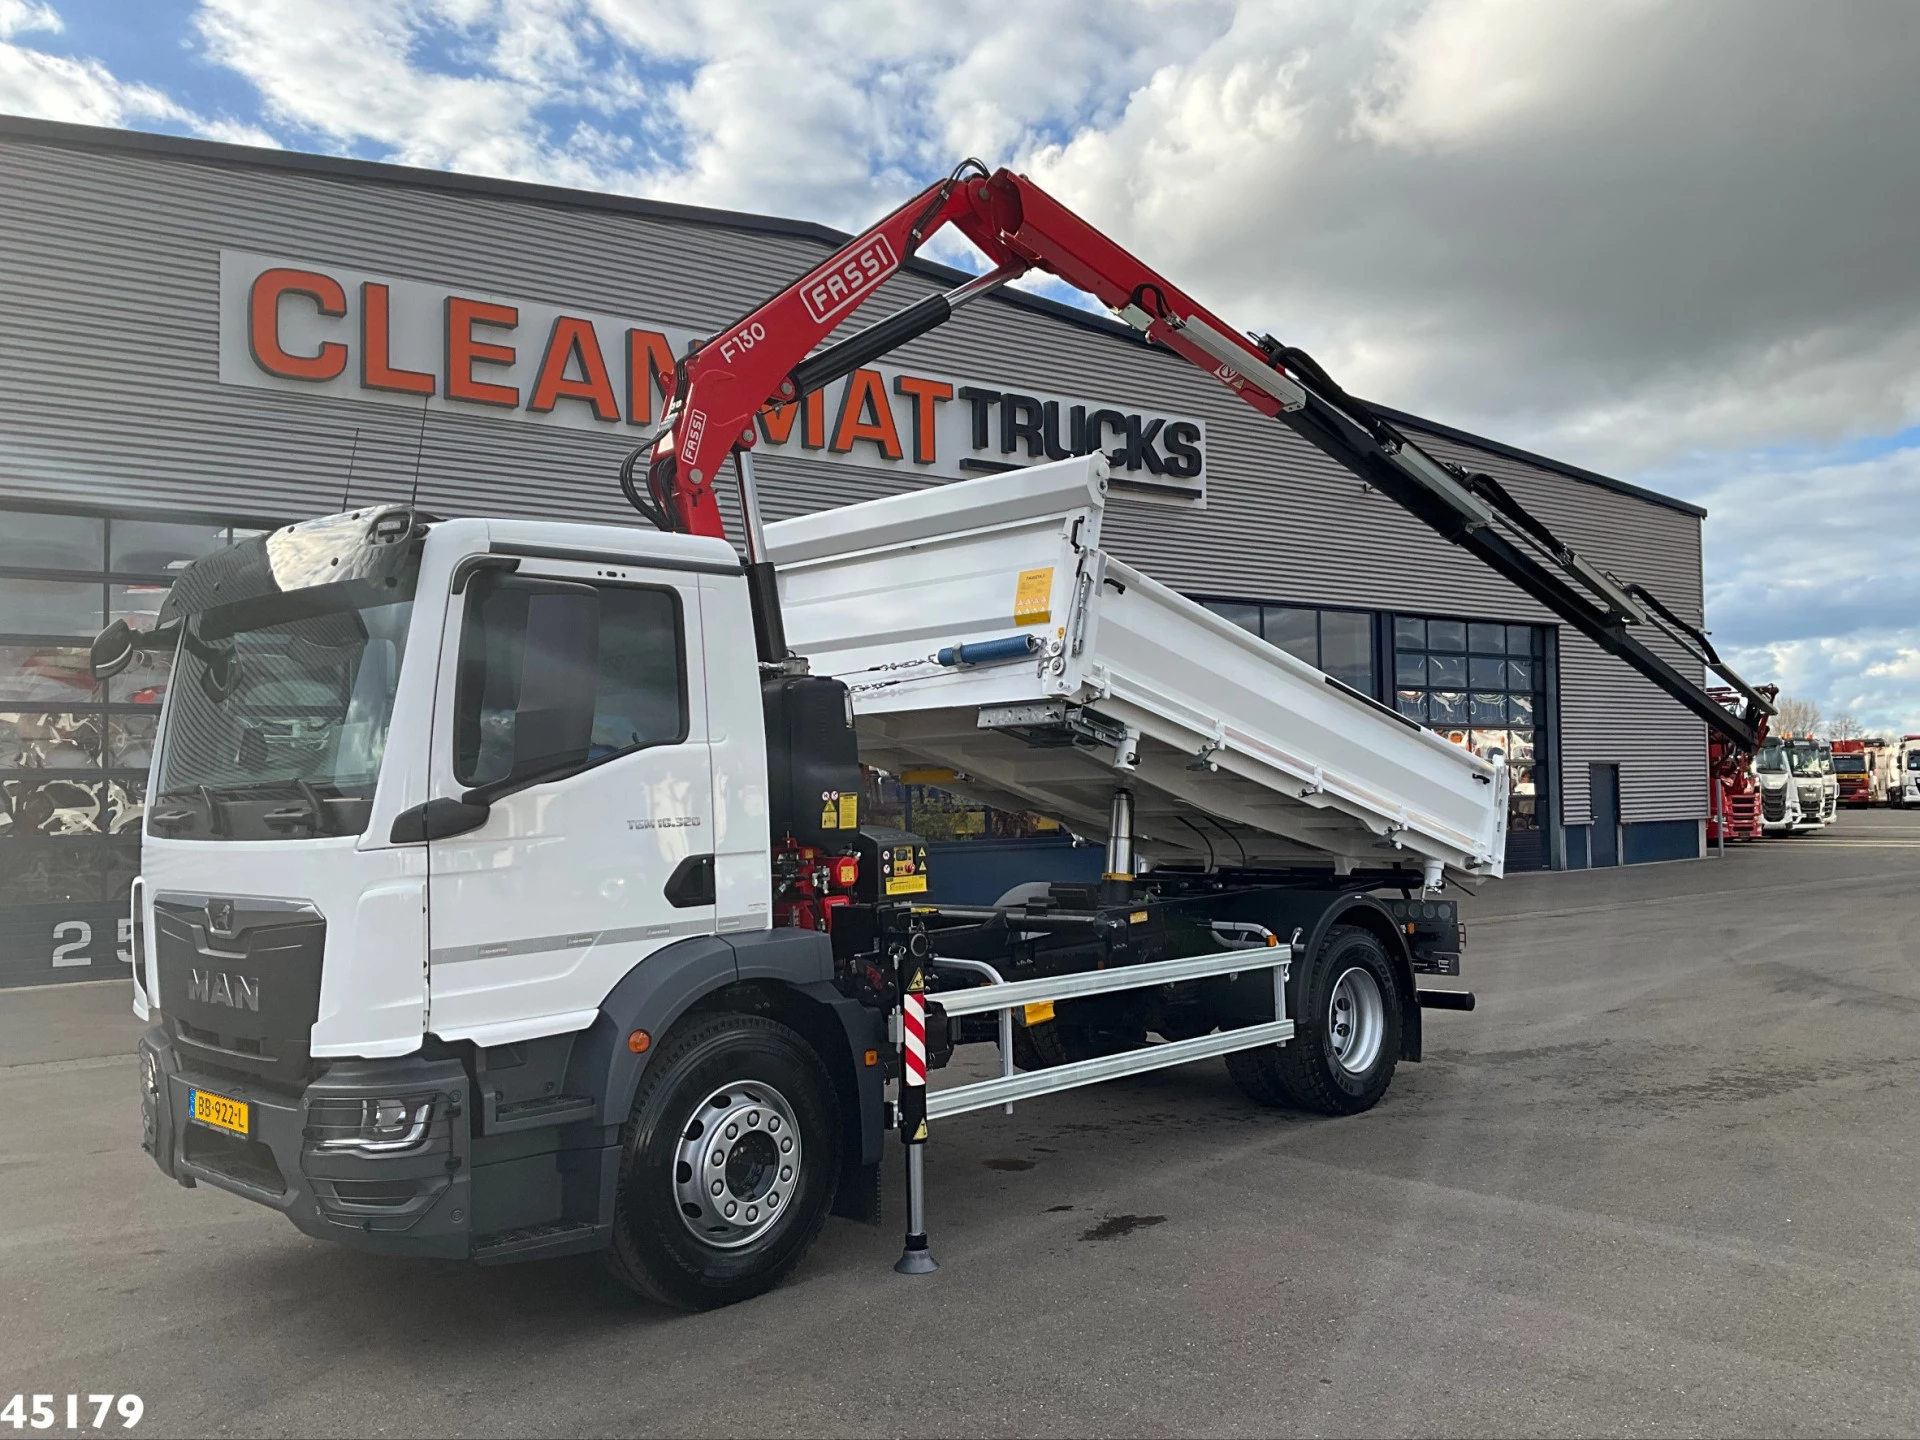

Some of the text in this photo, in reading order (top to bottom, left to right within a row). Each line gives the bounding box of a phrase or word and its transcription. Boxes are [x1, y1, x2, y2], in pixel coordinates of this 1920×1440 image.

[812, 245, 887, 312] FASSI
[720, 322, 765, 363] F130
[685, 415, 704, 464] FASSI
[958, 386, 1202, 478] TRUCKS
[188, 969, 259, 1012] MAN
[198, 1096, 245, 1128] BB-922-L
